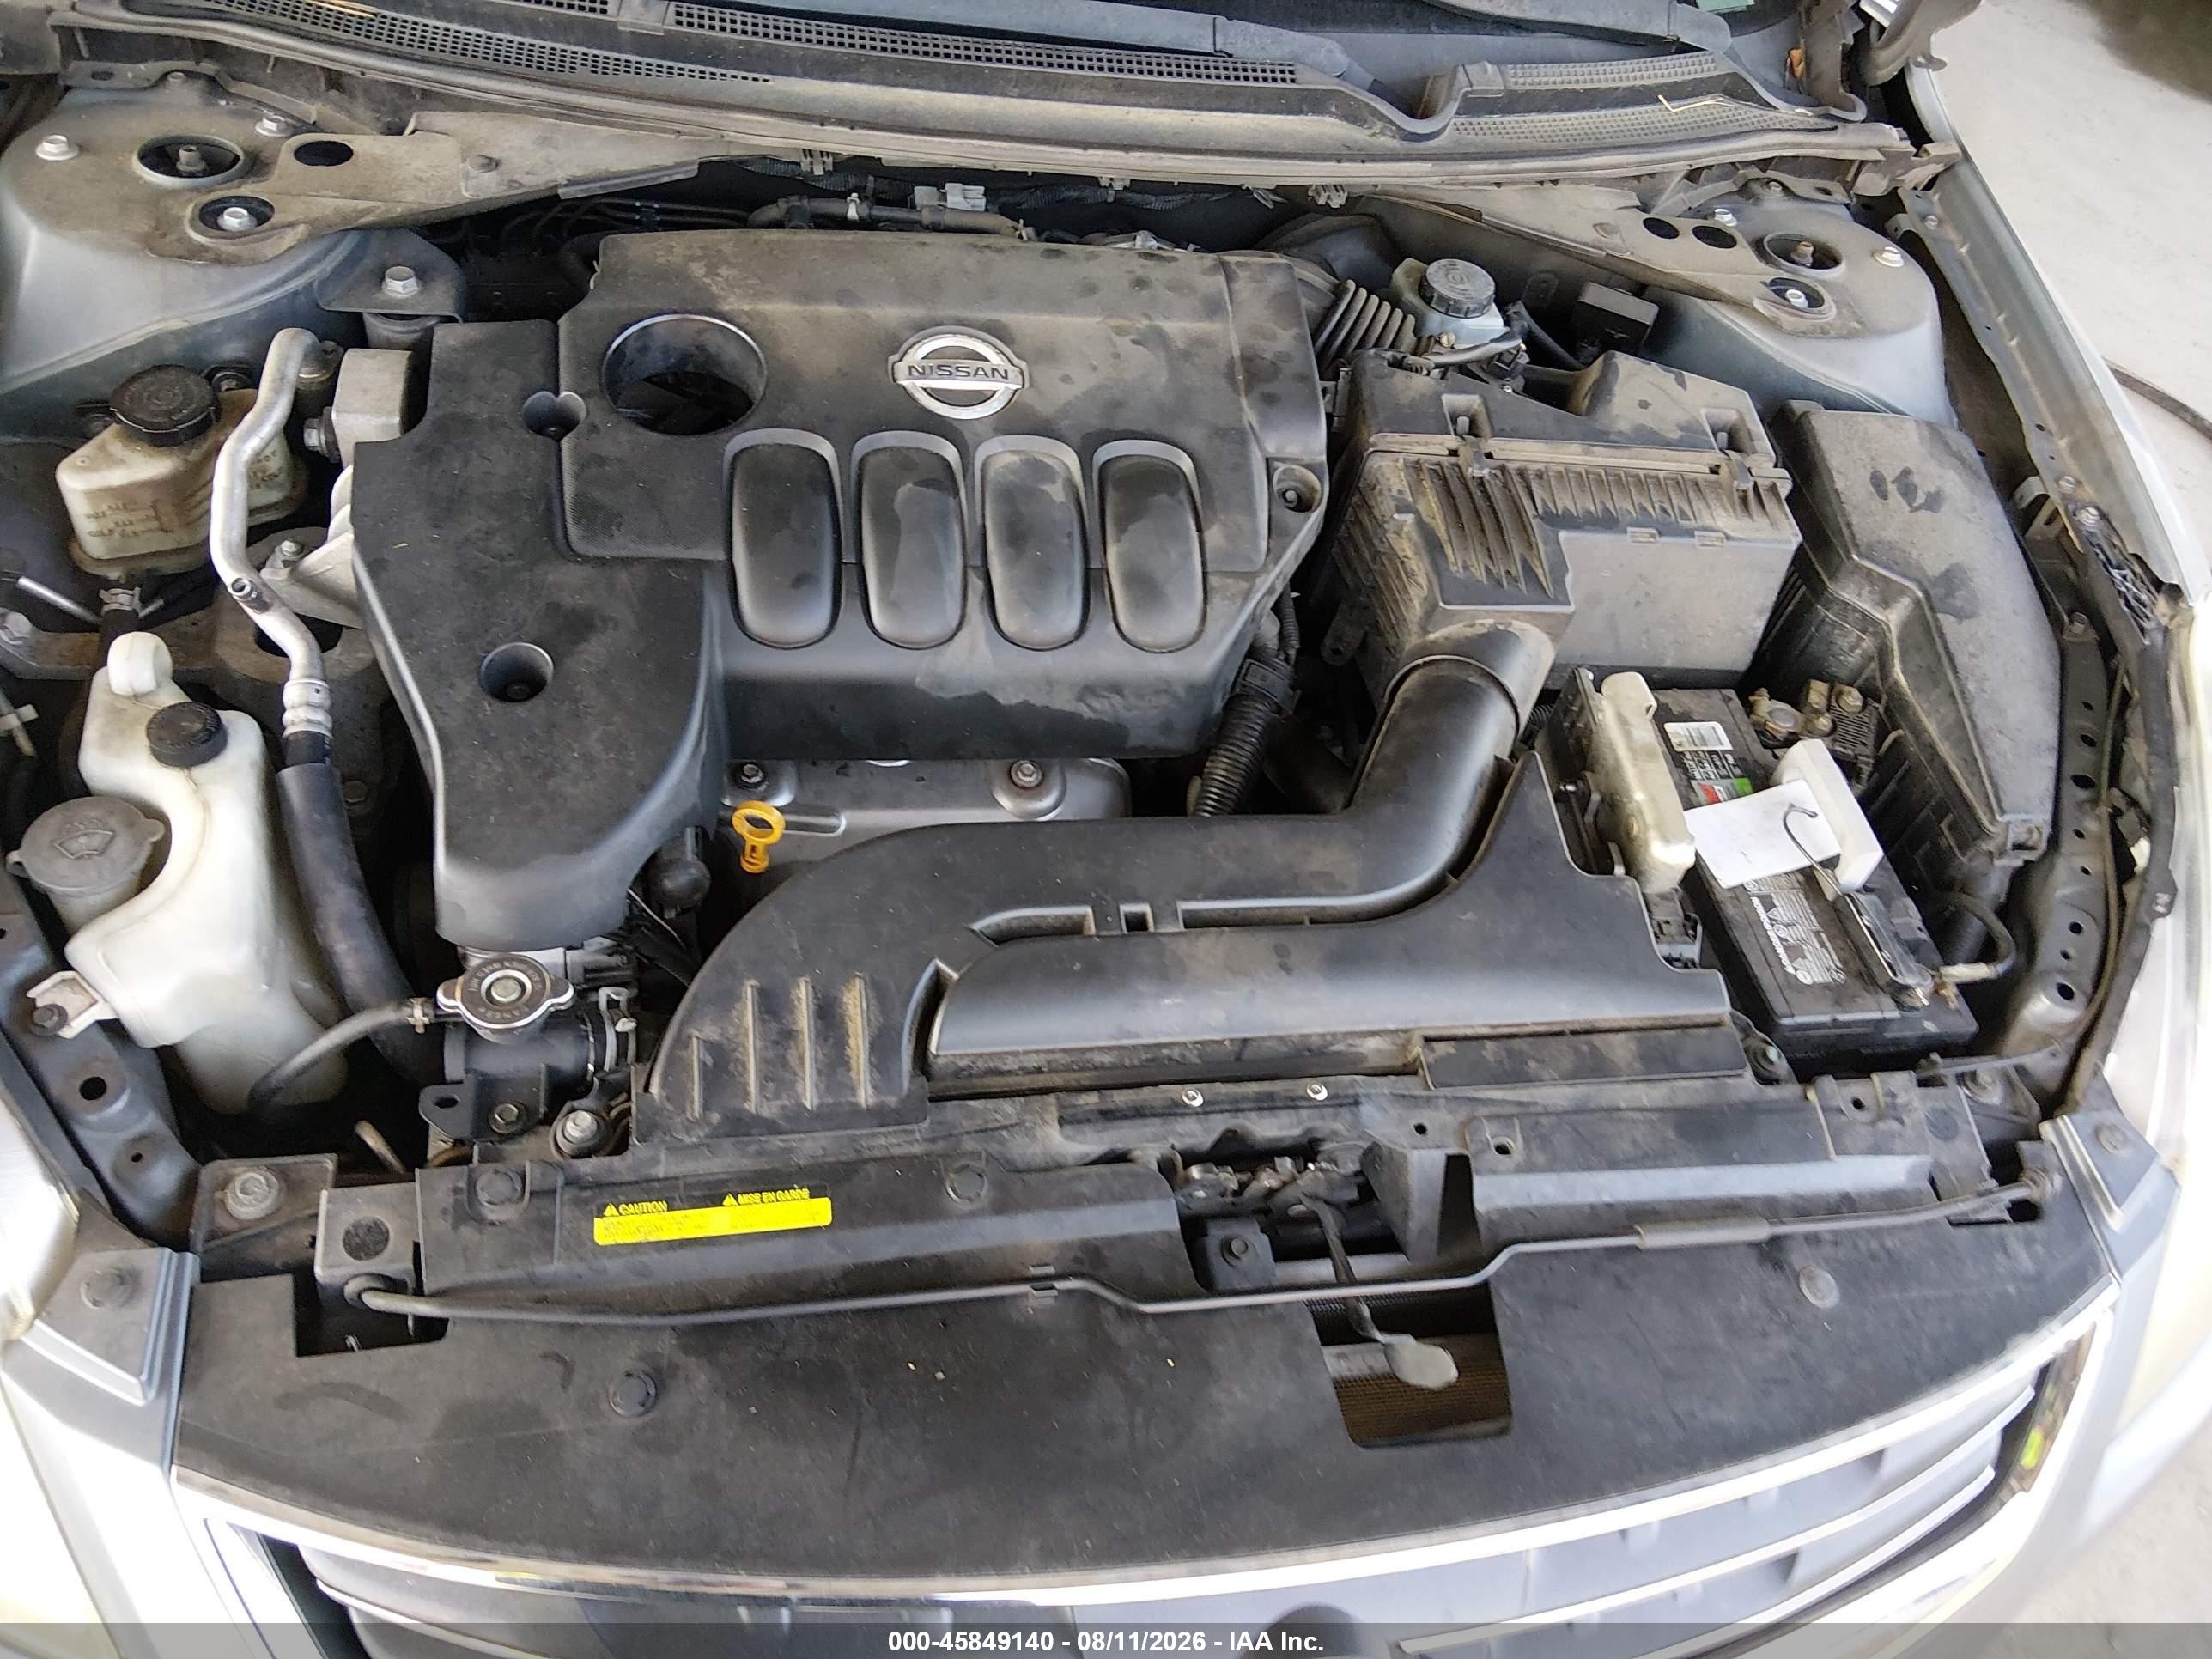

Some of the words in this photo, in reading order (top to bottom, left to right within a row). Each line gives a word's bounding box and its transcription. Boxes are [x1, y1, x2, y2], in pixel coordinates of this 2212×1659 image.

[908, 364, 1009, 380] NISSAN
[738, 1192, 762, 1206] MISE
[761, 1191, 776, 1203] EN
[775, 1188, 810, 1202] GARDE
[618, 1200, 668, 1216] CAUTION
